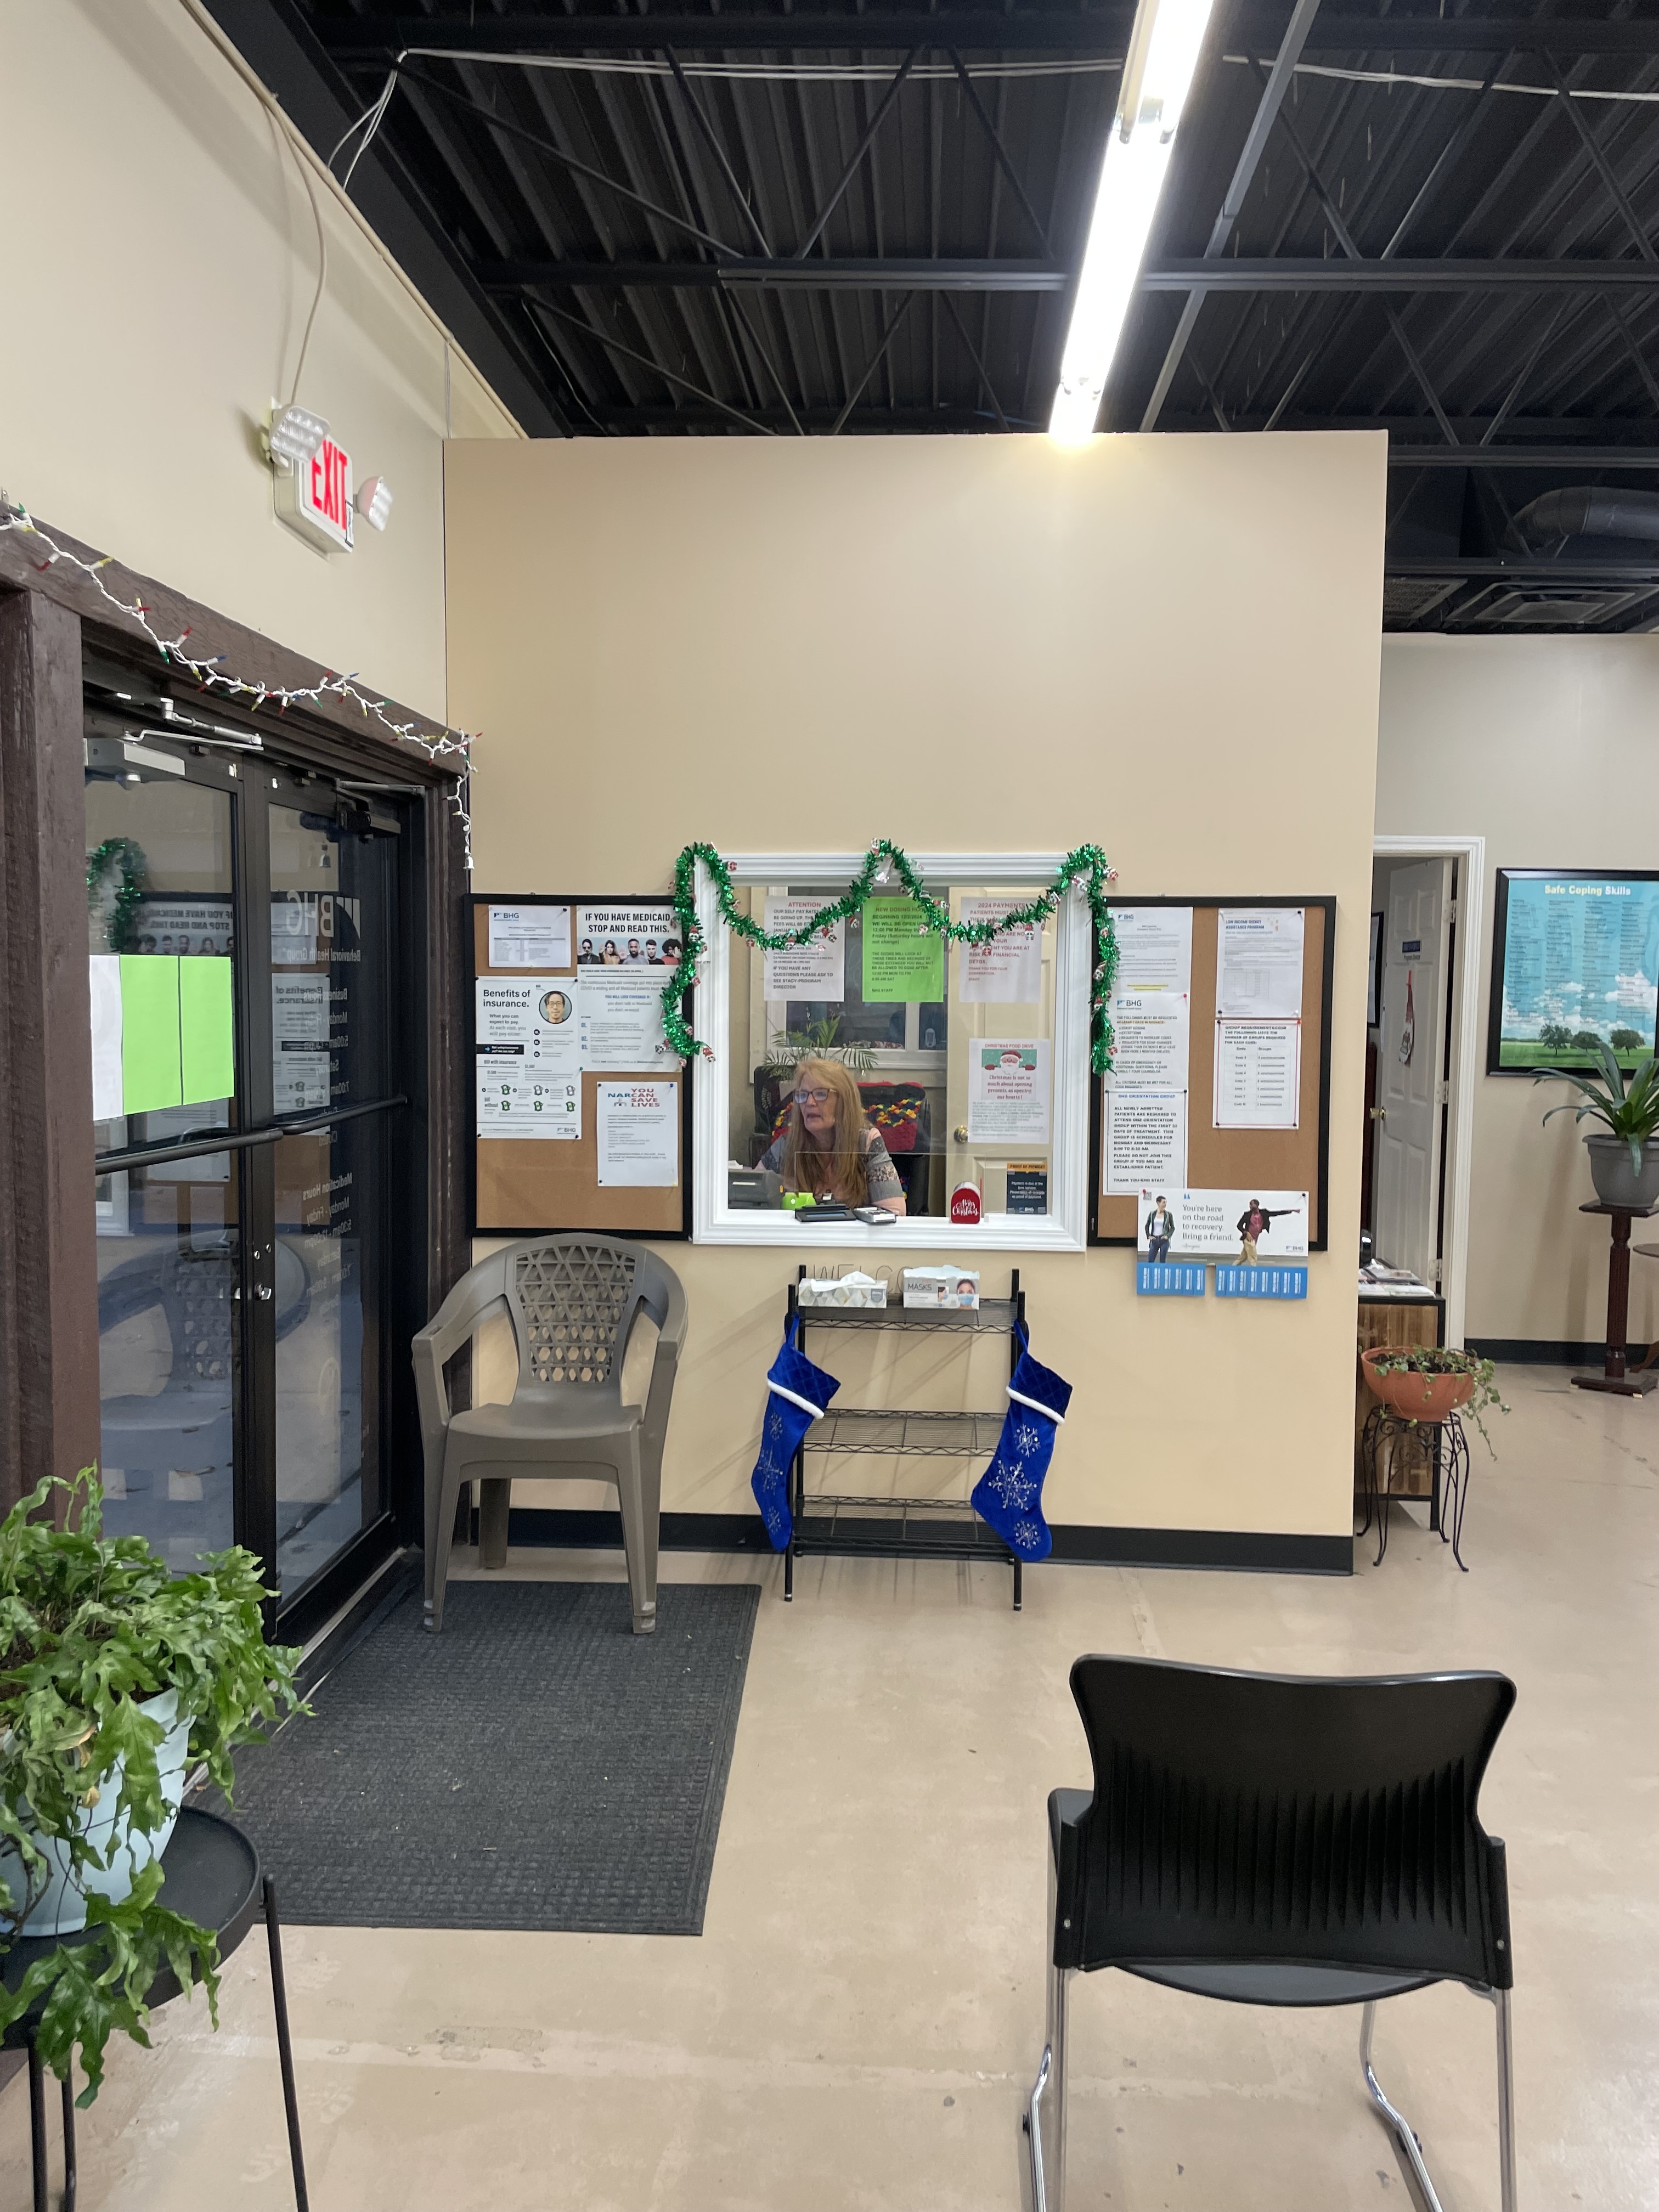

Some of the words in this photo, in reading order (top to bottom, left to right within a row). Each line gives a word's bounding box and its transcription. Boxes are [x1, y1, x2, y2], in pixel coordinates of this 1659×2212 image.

[312, 439, 348, 531] EXIT
[1544, 884, 1566, 894] Safe
[1568, 885, 1602, 896] Coping
[1605, 885, 1631, 896] Skills
[585, 913, 592, 921] IF
[594, 913, 609, 921] YOU
[611, 913, 631, 921] HAVE
[633, 913, 670, 922] MEDICAID
[588, 924, 608, 933] STOP
[610, 924, 625, 933] AND
[483, 989, 520, 997] Benefits
[522, 989, 531, 997] of
[483, 999, 529, 1007] insurance.
[952, 1205, 978, 1217] Christmas
[1182, 1204, 1204, 1212] You're
[1182, 1233, 1203, 1242] Bring
[1210, 1233, 1234, 1242] friend.
